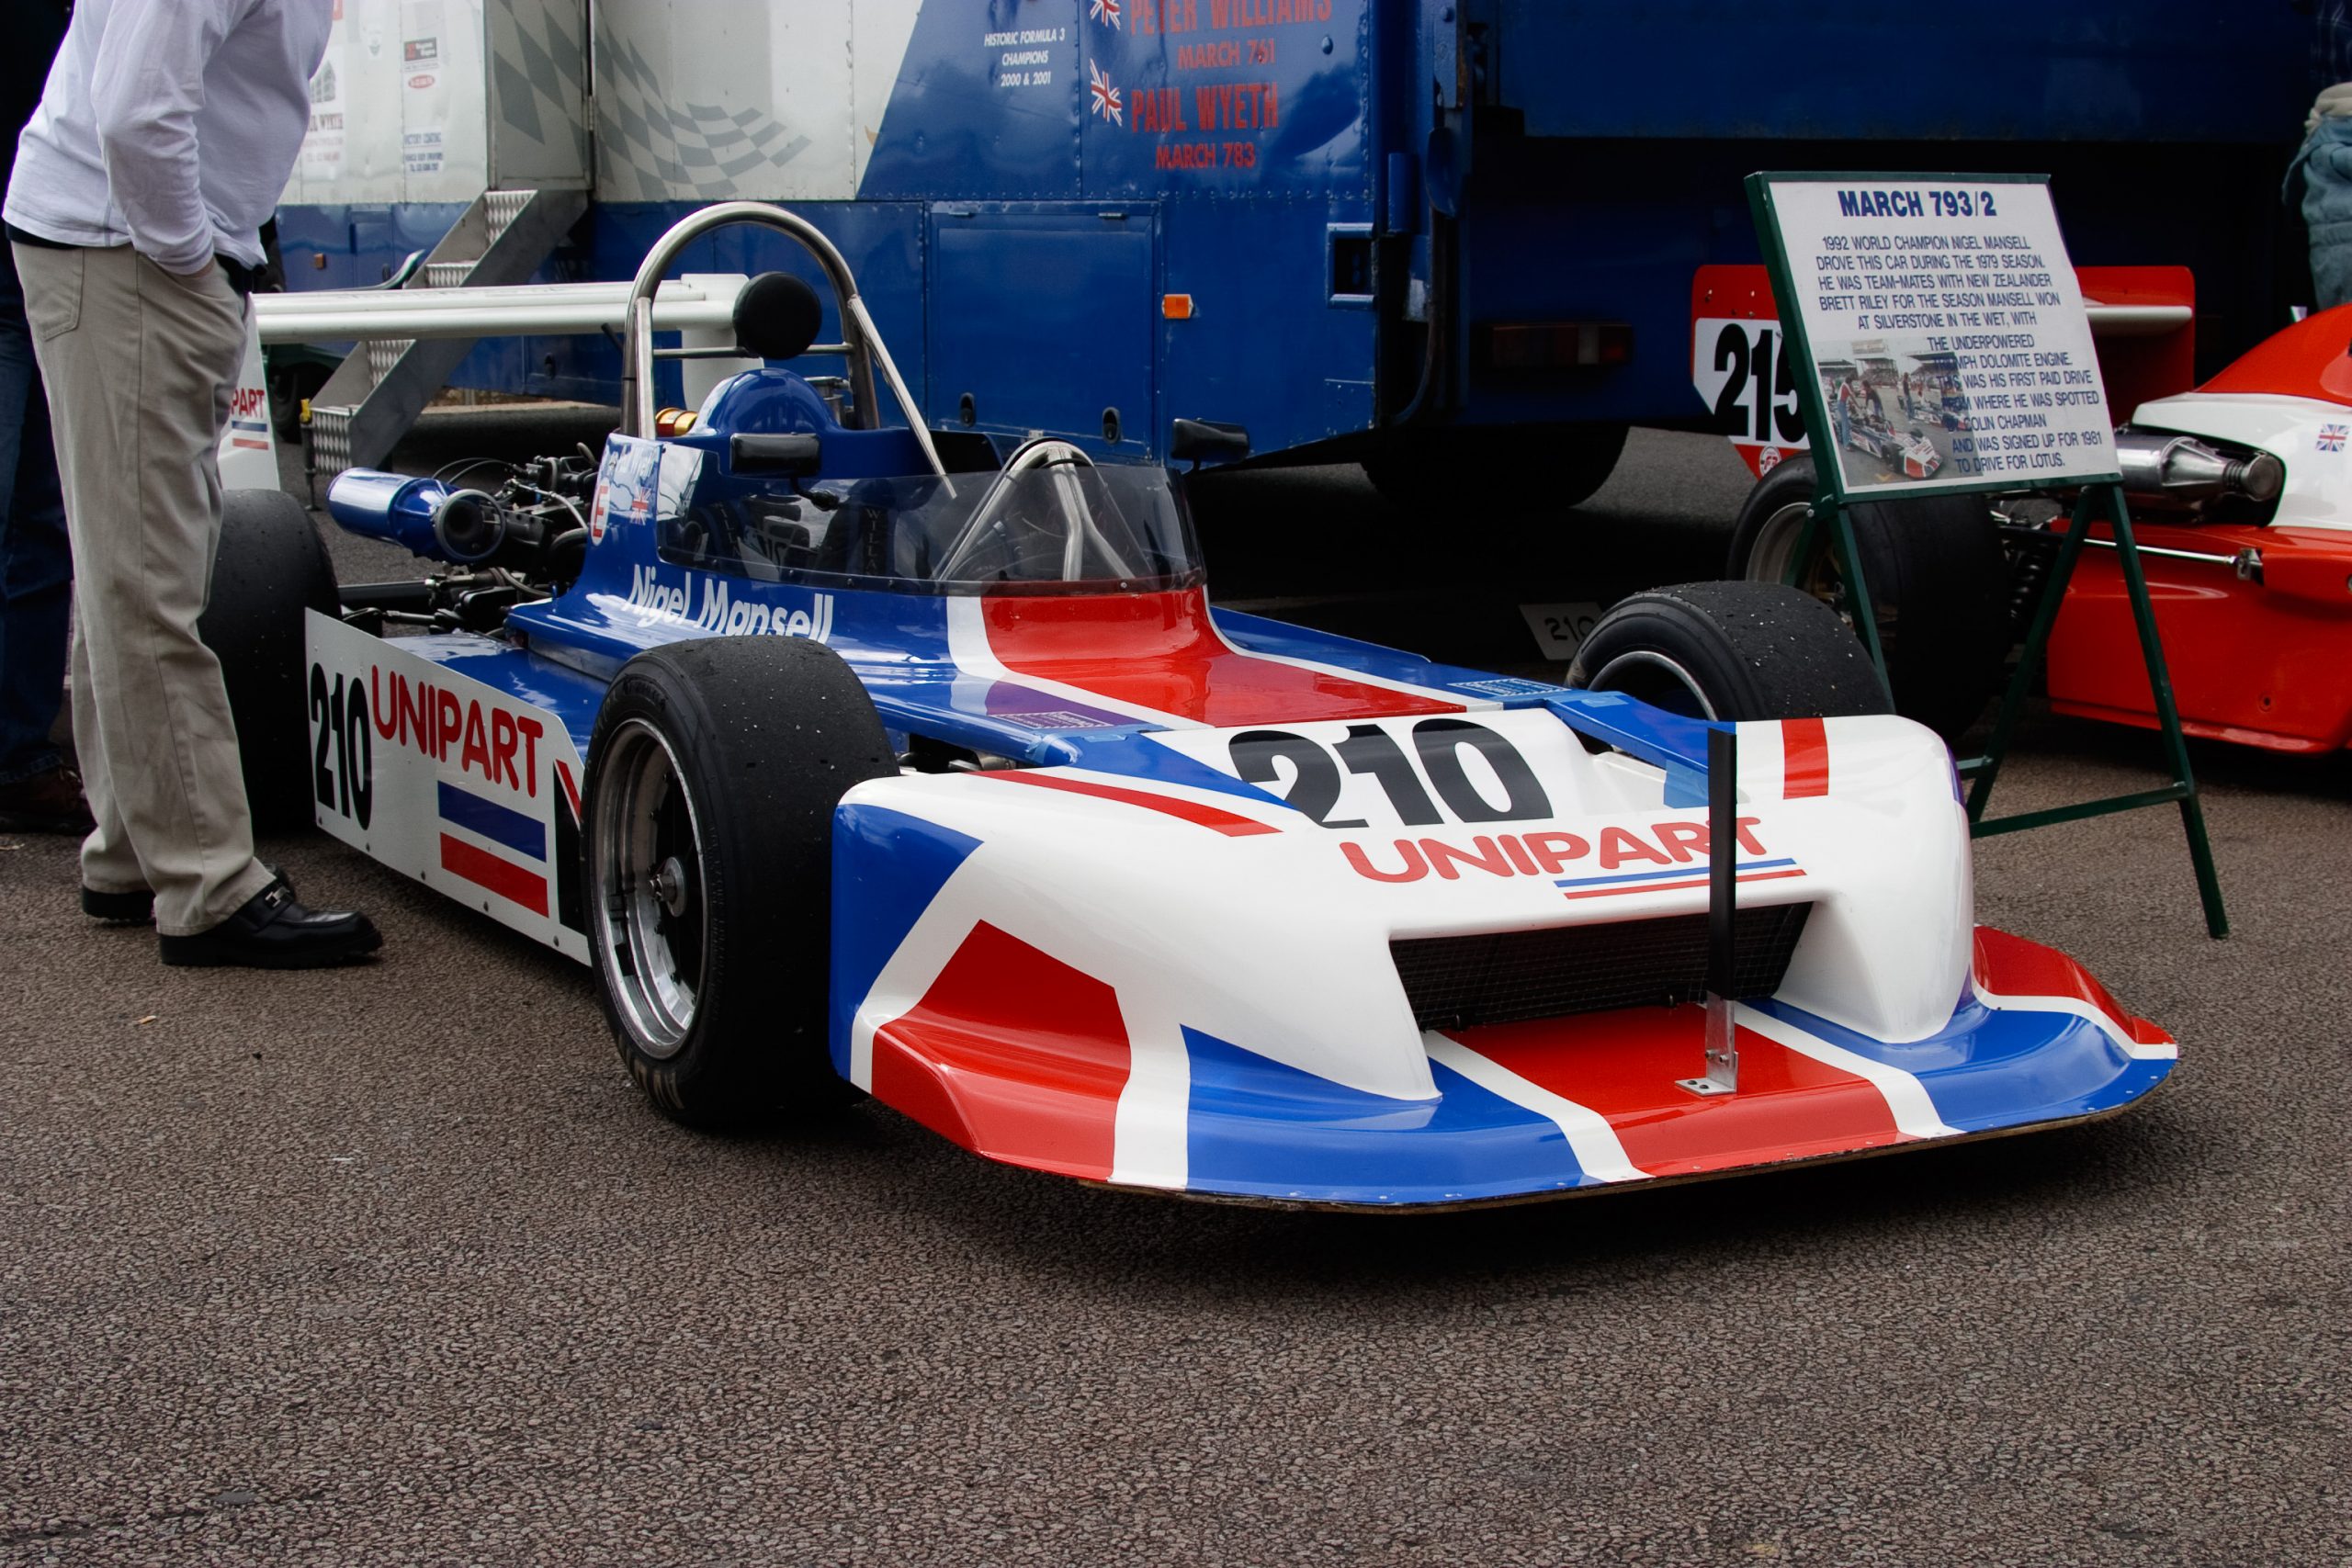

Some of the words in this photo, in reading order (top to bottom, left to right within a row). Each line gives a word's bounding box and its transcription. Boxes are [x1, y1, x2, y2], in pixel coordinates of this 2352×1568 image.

[1130, 0, 1197, 36] PETER
[984, 32, 1018, 47] HISTORIC
[1020, 28, 1057, 44] FORMULA
[1059, 28, 1066, 41] 3
[1001, 51, 1049, 66] CHAMPIONS
[1178, 41, 1240, 71] MARCH
[1247, 38, 1275, 65] 761
[1001, 73, 1022, 87] 2000
[1023, 73, 1030, 85] &
[1033, 71, 1051, 85] 2001
[1131, 88, 1187, 133] PAUL
[1196, 82, 1279, 131] WYETH
[1156, 143, 1216, 170] MARCH
[1223, 141, 1256, 168] 783
[1838, 190, 1925, 218] MARCH
[1929, 190, 1997, 218] 793/2
[1823, 235, 1849, 251] 1992
[1851, 235, 1891, 250] WORLD
[1894, 235, 1949, 250] CHAMPION
[1951, 235, 1982, 249] NIGEL
[1984, 235, 2031, 249] MANSELL
[1815, 256, 1855, 270] DROVE
[1857, 255, 1883, 270] THIS
[1885, 255, 1908, 269] CAR
[1911, 254, 1951, 269] DURING
[1952, 255, 1973, 268] THE
[1975, 254, 1999, 268] 1979
[2001, 254, 2045, 268] SEASON.
[1818, 276, 1835, 290] HE
[1837, 276, 1862, 290] WAS
[1864, 275, 1935, 289] TEAM-MATES
[1937, 274, 1964, 288] WITH
[1966, 274, 1989, 288] NEW
[1993, 274, 2052, 288] ZEALANDER
[1819, 296, 1855, 310] BRETT
[1859, 295, 1888, 310] RILEY
[1892, 294, 1916, 310] FOR
[1917, 294, 1939, 308] THE
[1941, 292, 1984, 308] SEASON
[1986, 292, 2034, 307] MANSELL
[2035, 292, 2061, 306] WON
[1858, 315, 1870, 330] AT
[1873, 313, 1945, 329] SILVERSTONE
[1946, 313, 1958, 327] IN
[1960, 312, 1981, 326] THE
[1983, 312, 2010, 328] WET,
[2010, 311, 2037, 325] WITH
[1927, 336, 1949, 351] THE
[1951, 334, 2035, 350] UNDERPOWERED
[1980, 353, 2032, 368] DOLOMITE
[1714, 323, 1807, 443] 215
[1936, 374, 1962, 389] THIS
[1962, 373, 1986, 389] WAS
[1988, 373, 2007, 388] HIS
[2008, 371, 2036, 387] FIRST
[2039, 371, 2061, 385] PAID
[2063, 369, 2093, 384] DRIVE
[1973, 394, 2011, 410] WHERE
[2013, 393, 2029, 408] HE
[2030, 392, 2052, 407] WAS
[2054, 390, 2099, 406] SPOTTED
[1963, 416, 1995, 432] COLIN
[1997, 413, 2047, 430] CHAPMAN
[1952, 437, 1973, 453] AND
[1975, 435, 1999, 452] WAS
[2001, 434, 2039, 450] SIGNED
[2041, 433, 2055, 448] UP
[2057, 432, 2079, 447] FOR
[2081, 430, 2102, 446] 1981
[1955, 457, 1971, 473] TO
[1973, 456, 2004, 472] DRIVE
[2006, 454, 2029, 470] FOR
[2030, 452, 2065, 468] LOTUS.
[621, 565, 692, 628] Nigel
[695, 578, 834, 644] Mansell
[371, 664, 544, 798] UNIPART
[311, 661, 372, 831] 210
[1229, 718, 1555, 829] 210
[1339, 817, 1768, 884] UNIPART
